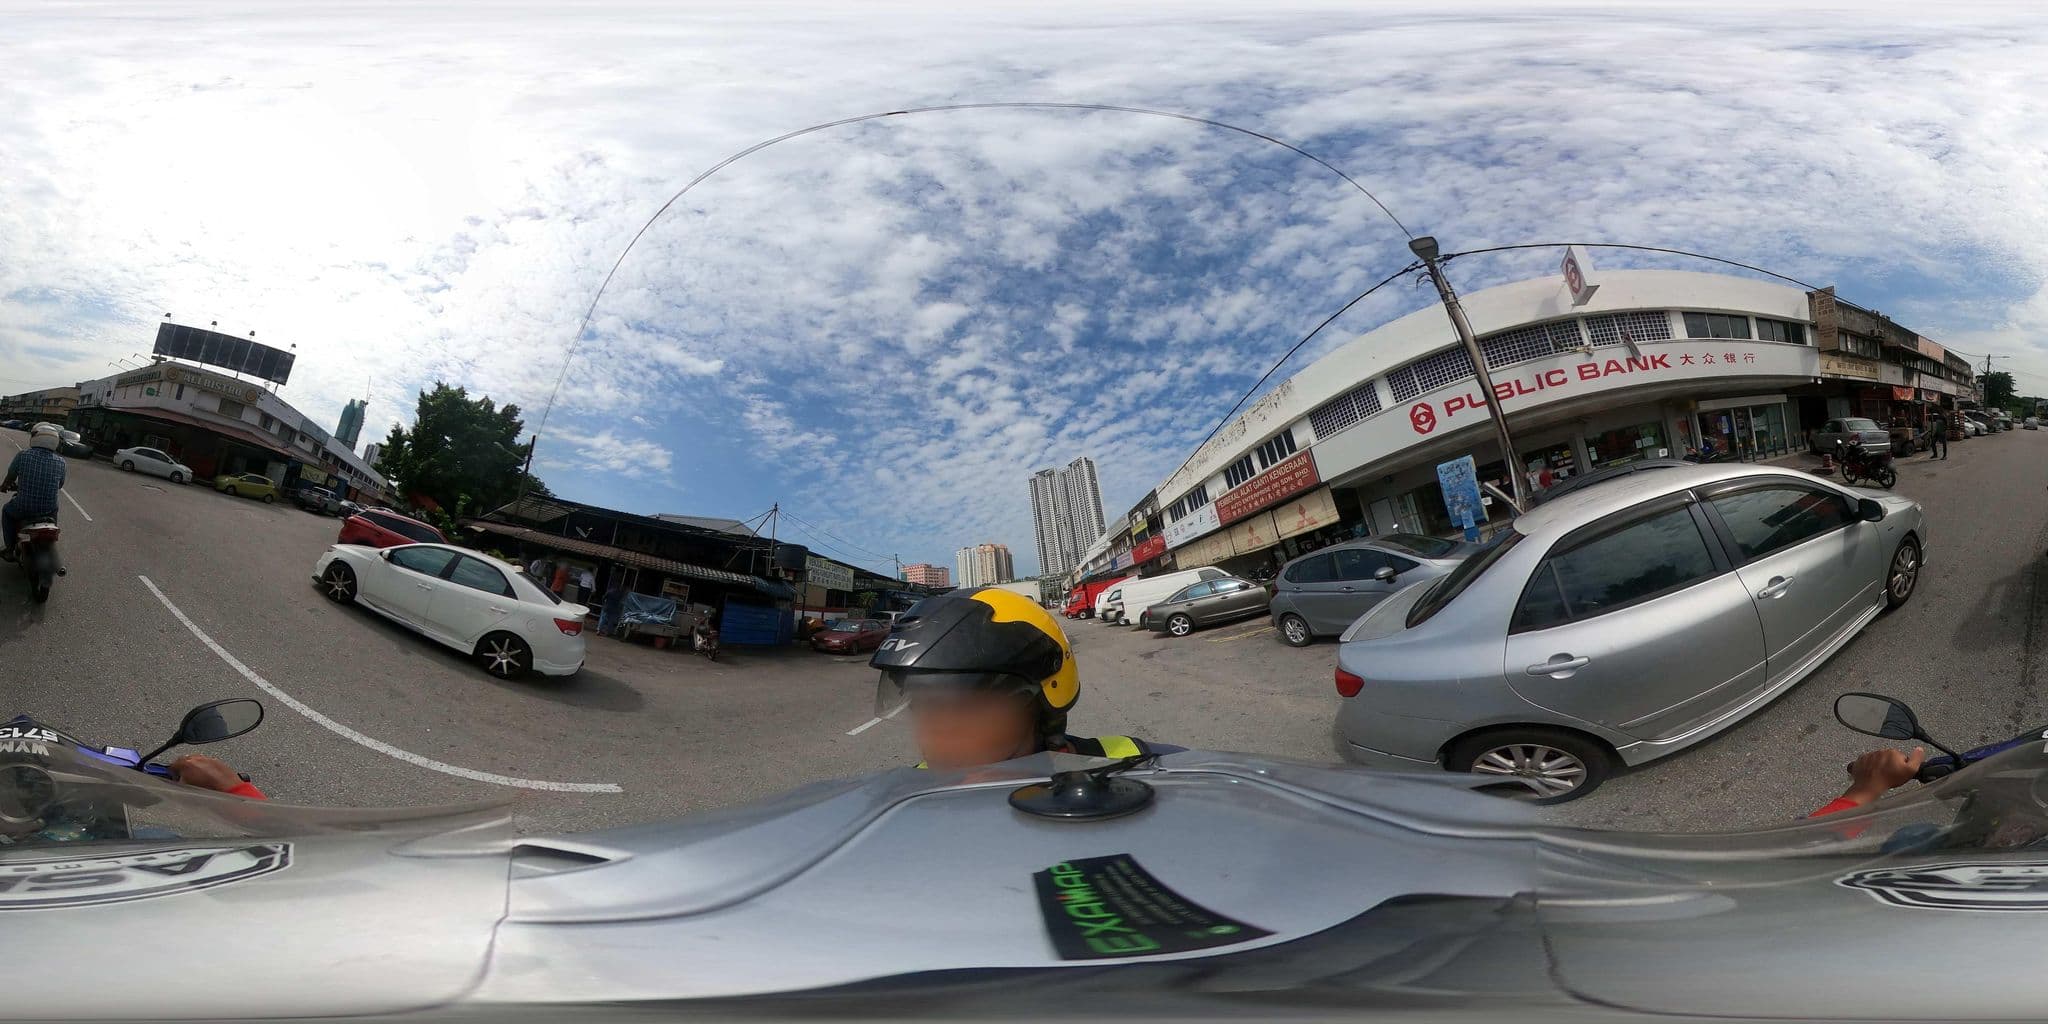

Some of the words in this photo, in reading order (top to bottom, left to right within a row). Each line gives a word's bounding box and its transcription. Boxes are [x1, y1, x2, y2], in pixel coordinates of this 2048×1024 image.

[1680, 352, 1756, 366] 大众银行
[1443, 369, 1568, 417] PUBLIC
[1576, 353, 1672, 381] BANK
[1269, 455, 1308, 480] KENDERAAN
